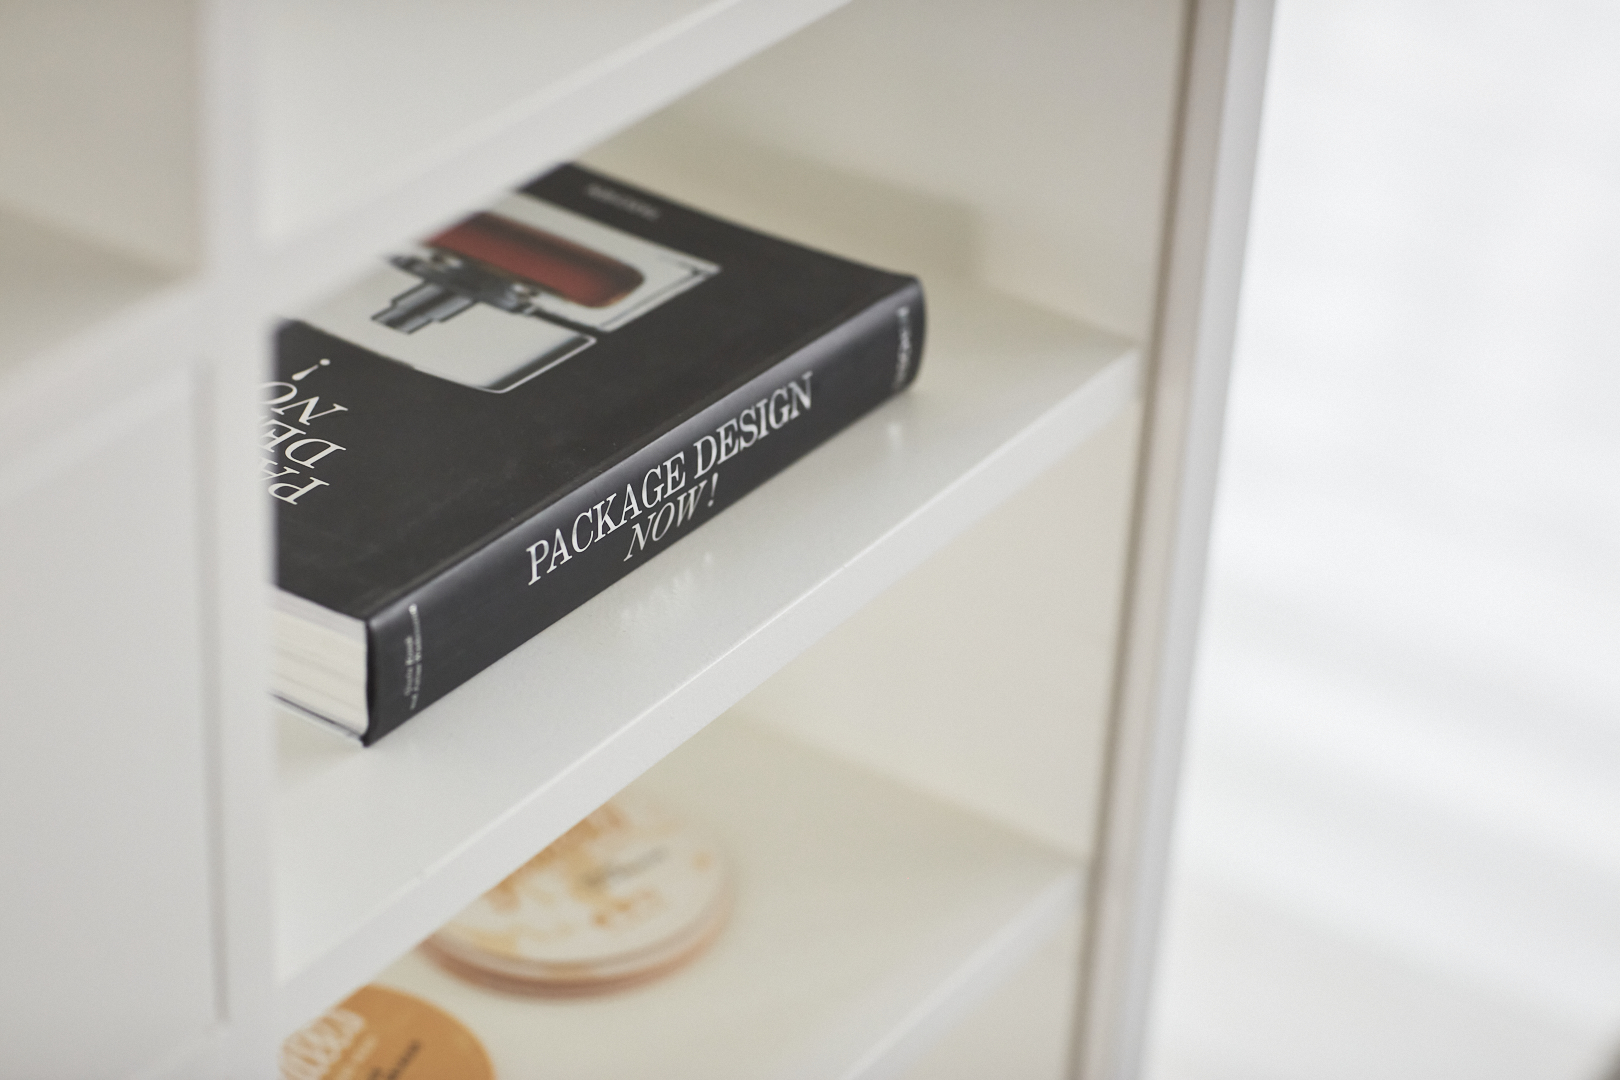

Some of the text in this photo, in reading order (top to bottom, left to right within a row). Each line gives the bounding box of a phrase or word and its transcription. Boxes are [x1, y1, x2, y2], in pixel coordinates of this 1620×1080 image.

[526, 371, 813, 586] PACKAGE DESIGN
[623, 472, 719, 563] NOW!
